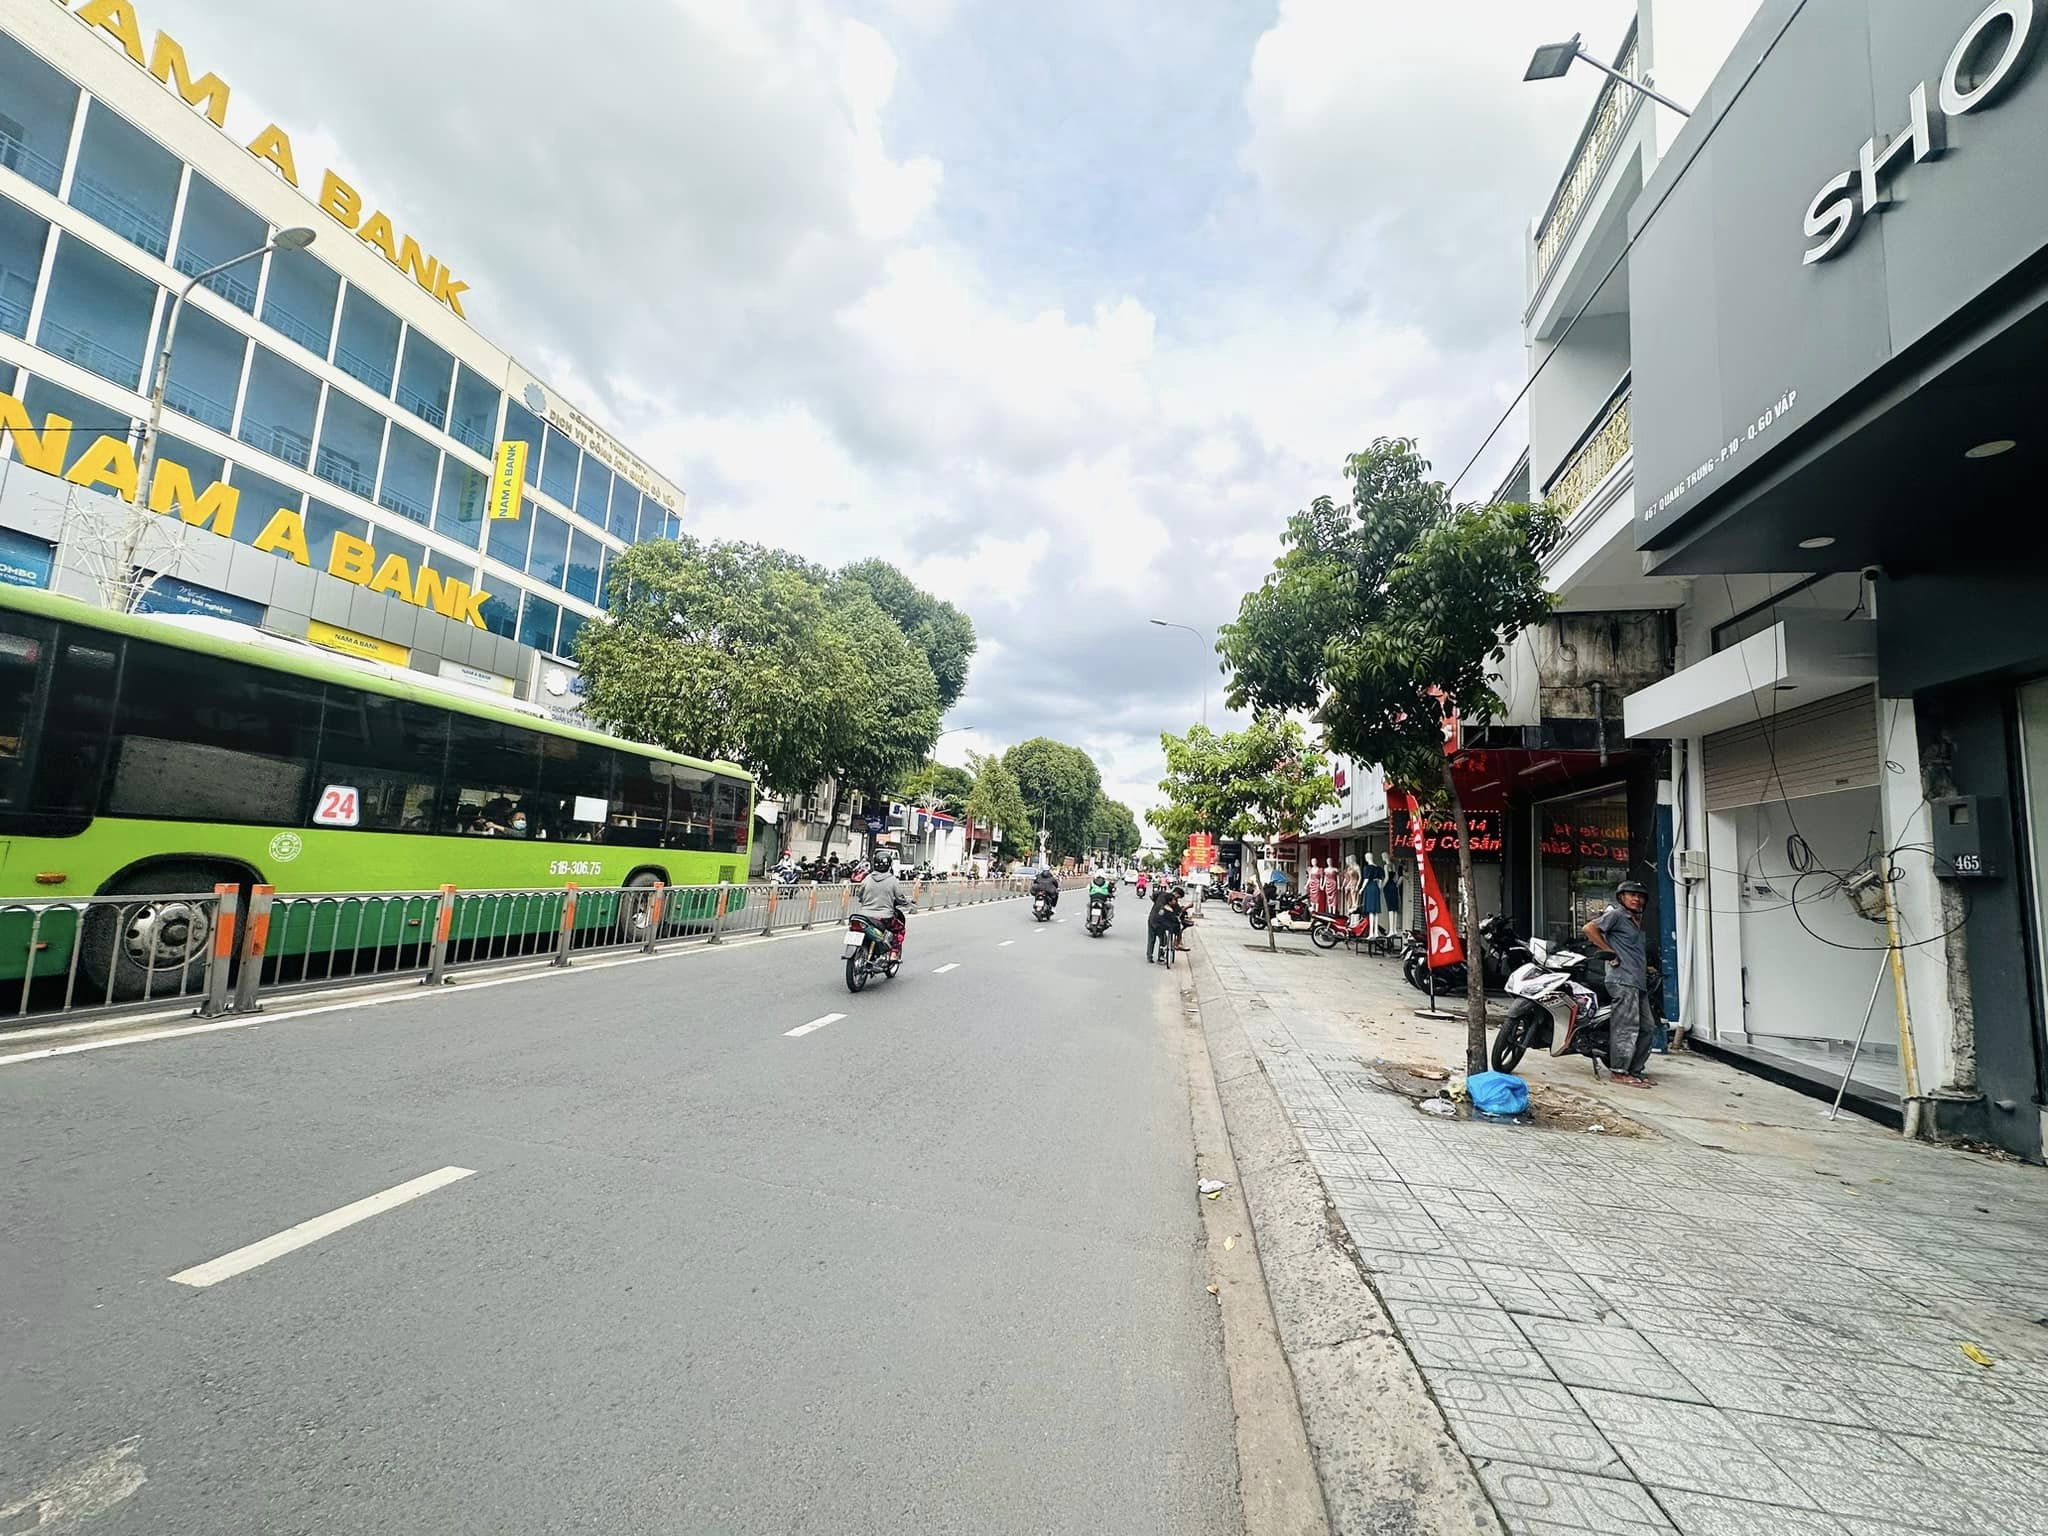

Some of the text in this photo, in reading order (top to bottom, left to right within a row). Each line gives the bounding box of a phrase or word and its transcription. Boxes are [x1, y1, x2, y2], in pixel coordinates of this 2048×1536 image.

[58, 0, 471, 320] AM A BANK
[1802, 0, 2034, 265] SHO
[499, 445, 516, 517] NAM A BANK
[1659, 481, 1685, 511] QUANG
[1686, 458, 1715, 488] TRUNG
[1720, 437, 1739, 461] P.10
[1774, 388, 1797, 419] VẤP
[0, 391, 492, 631] NAM A BANK
[334, 632, 353, 645] NAM
[359, 640, 379, 651] BANK
[322, 791, 355, 819] 24
[1955, 854, 1980, 870] 465
